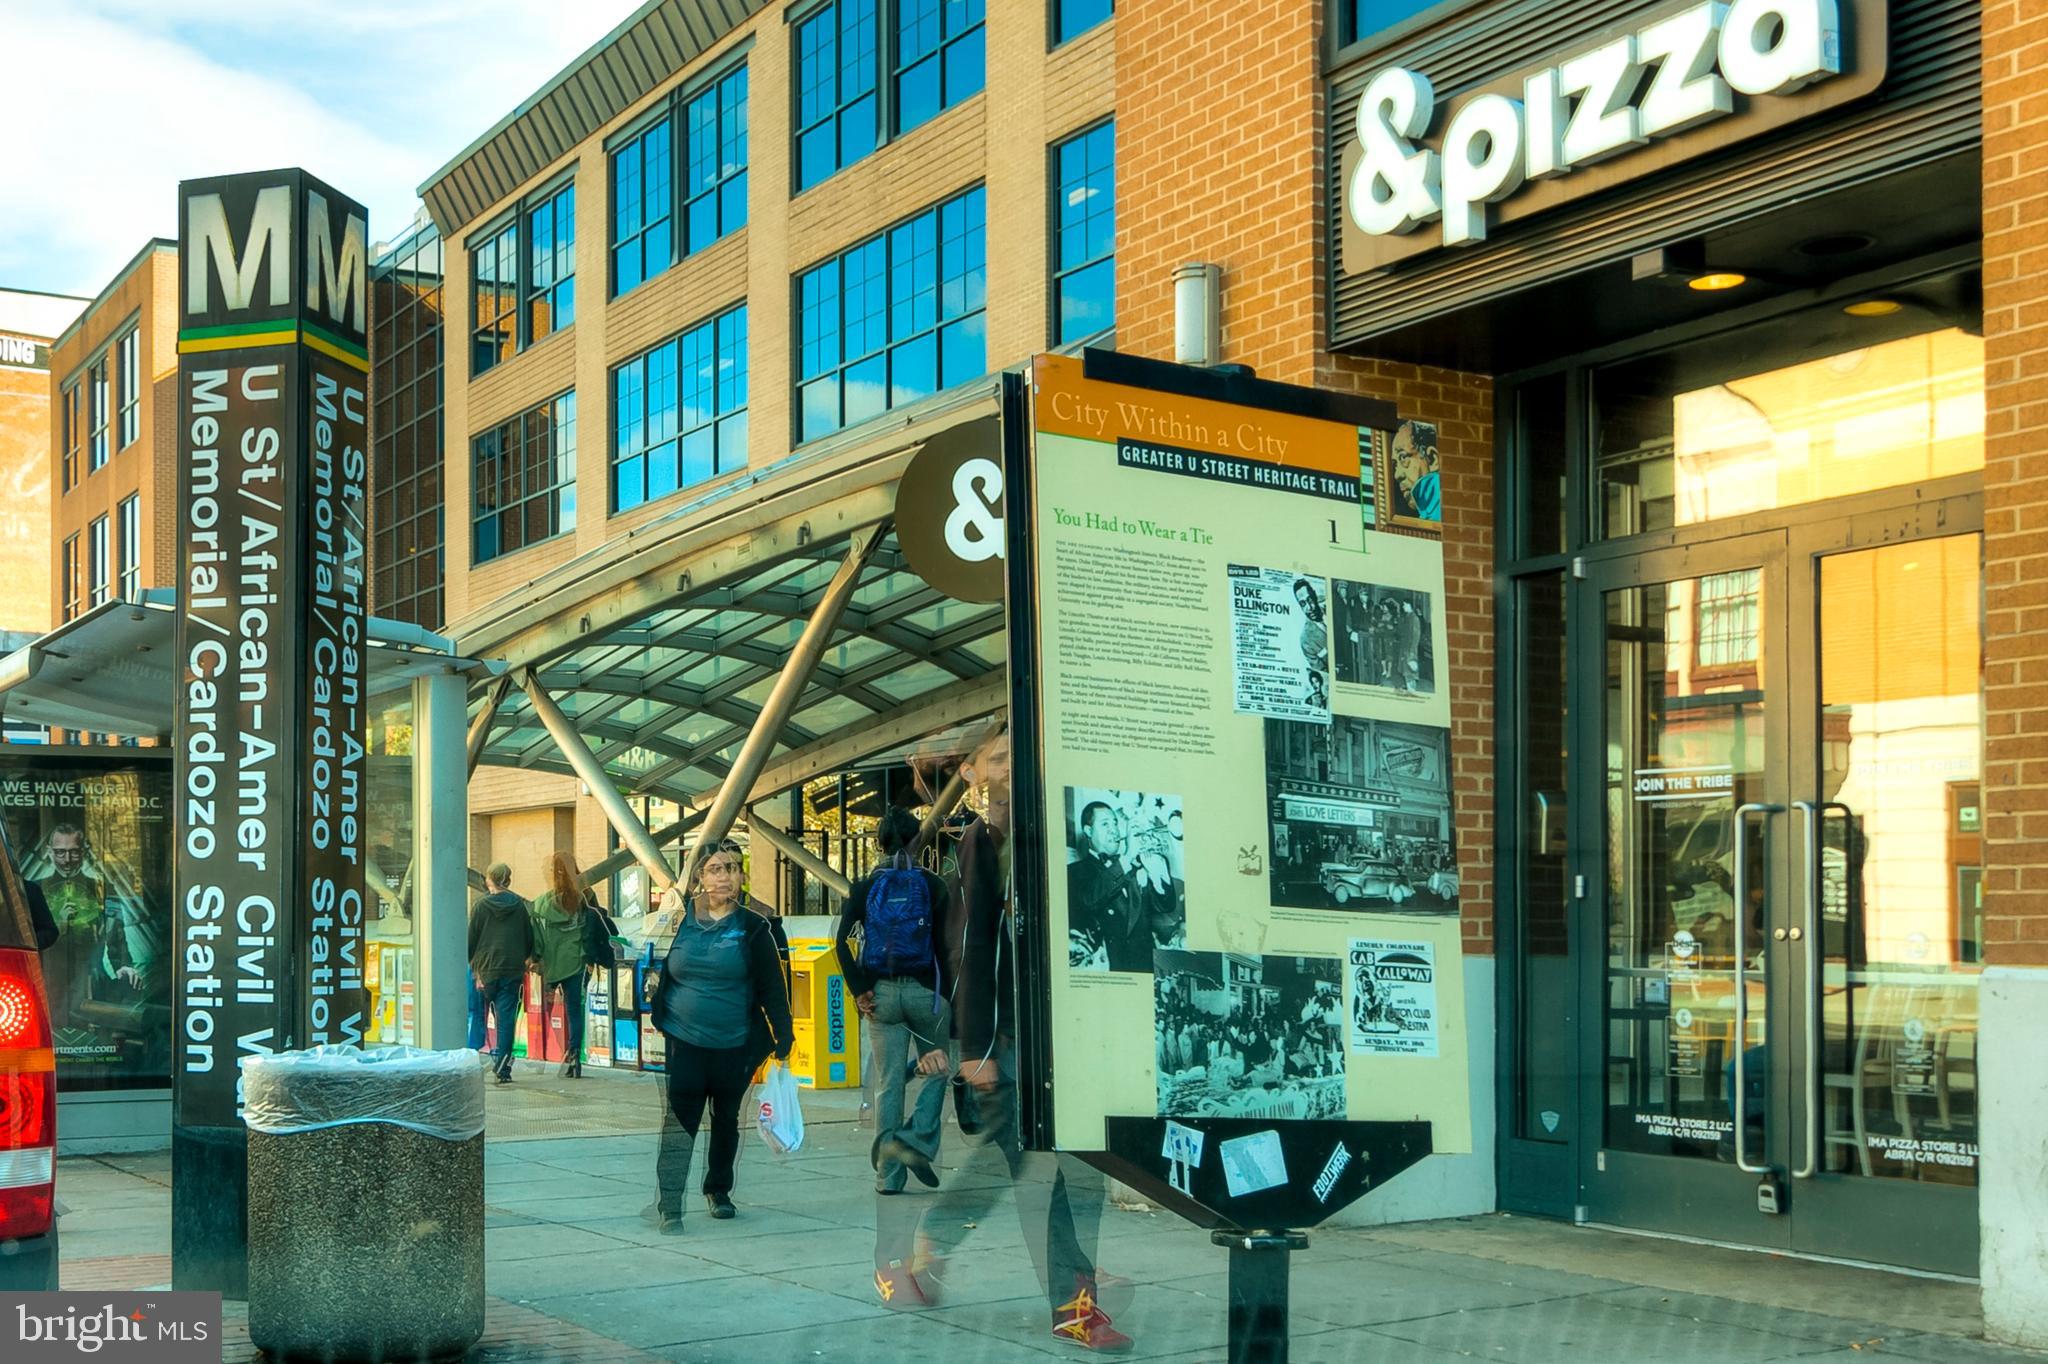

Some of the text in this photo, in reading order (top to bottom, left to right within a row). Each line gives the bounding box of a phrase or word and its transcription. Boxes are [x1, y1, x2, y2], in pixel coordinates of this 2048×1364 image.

[1349, 0, 1840, 246] &pizza
[187, 185, 291, 314] M
[307, 189, 366, 335] M
[0, 338, 35, 364] ING
[241, 364, 279, 400] U
[343, 386, 364, 426] U
[1051, 391, 1289, 465] City Within a City
[1122, 444, 1358, 499] GREATER U STREET HERITAGE TRAIL
[945, 458, 1005, 562] &
[1053, 508, 1213, 545] You Had to Wear a Tie
[1328, 519, 1340, 544] 1
[1234, 586, 1262, 600] DUKE
[1234, 598, 1290, 615] ELLINGTON
[186, 369, 230, 1073] Memorial/Cardozo Station
[3, 781, 126, 795] WE HAVE MORE
[40, 795, 55, 807] IN
[89, 796, 131, 808] THAN
[137, 797, 163, 808] D.C.
[1634, 775, 1733, 792] JOIN THE TRIBE
[236, 895, 276, 1003] Civil
[339, 888, 362, 990] Civil
[1352, 953, 1374, 964] CAB
[1376, 967, 1431, 982] CALLOWAY
[831, 978, 843, 1051] express
[1648, 1125, 1673, 1136] ABRA
[1674, 1128, 1690, 1138] C/R
[1653, 1115, 1678, 1127] PIZZA
[1680, 1118, 1708, 1130] STORE
[1709, 1121, 1715, 1129] 2
[1716, 1122, 1733, 1131] LLC
[1868, 1136, 1980, 1156] IMA PIZZA STORE 2 LL
[1884, 1149, 1974, 1167] ABRA C/R 092159
[1312, 1144, 1352, 1200] FOOTWERK
